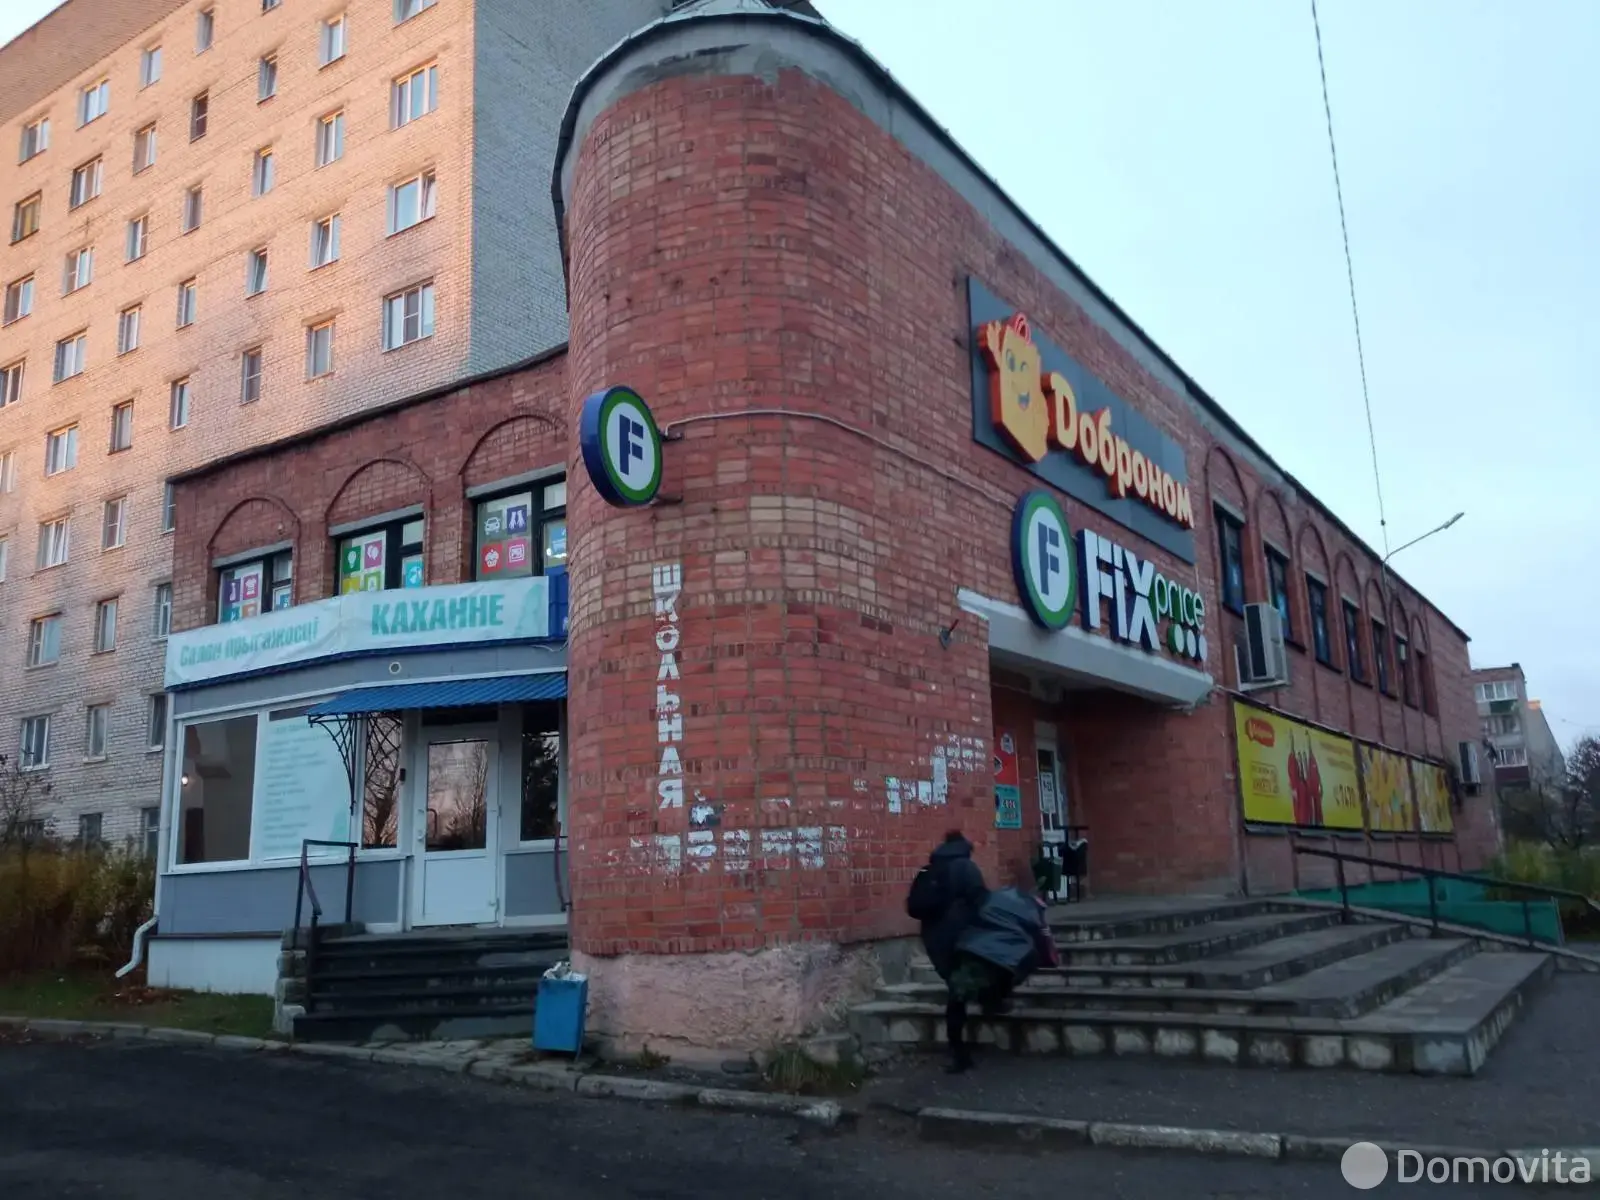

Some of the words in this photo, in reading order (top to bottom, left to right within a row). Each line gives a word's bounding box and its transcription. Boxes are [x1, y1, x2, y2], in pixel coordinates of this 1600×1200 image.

[619, 413, 644, 476] F
[1037, 521, 1060, 596] F
[371, 594, 505, 635] КАХАННЕ
[1154, 573, 1205, 630] price
[652, 564, 683, 809] ШКОЛЬНАЯ
